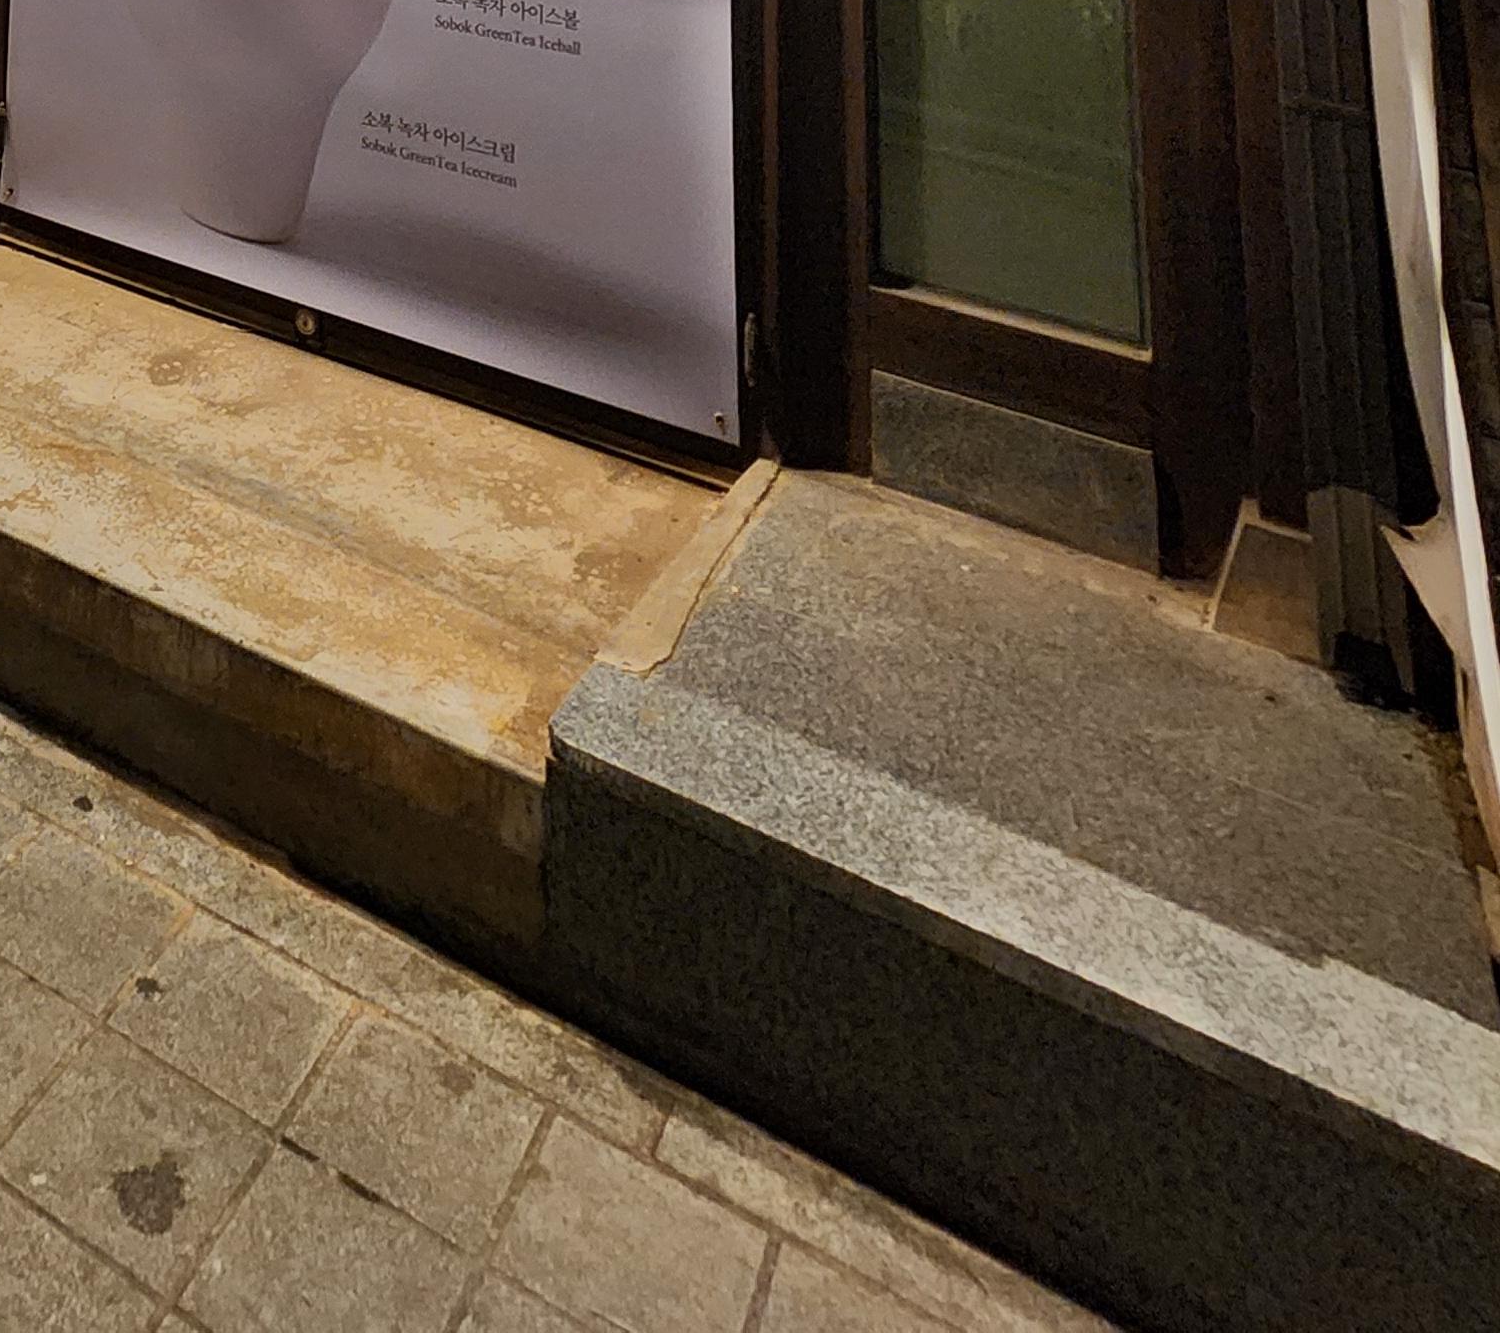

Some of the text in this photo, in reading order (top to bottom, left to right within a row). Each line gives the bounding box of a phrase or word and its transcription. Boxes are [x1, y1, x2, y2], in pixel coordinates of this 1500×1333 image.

[435, 14, 472, 33] Sobok
[539, 35, 581, 55] Iceball
[510, 0, 580, 31] 아이스볼
[362, 110, 516, 164] 소복 녹차 아이스크림
[361, 135, 397, 157] Sobok
[461, 161, 517, 188] Icecream
